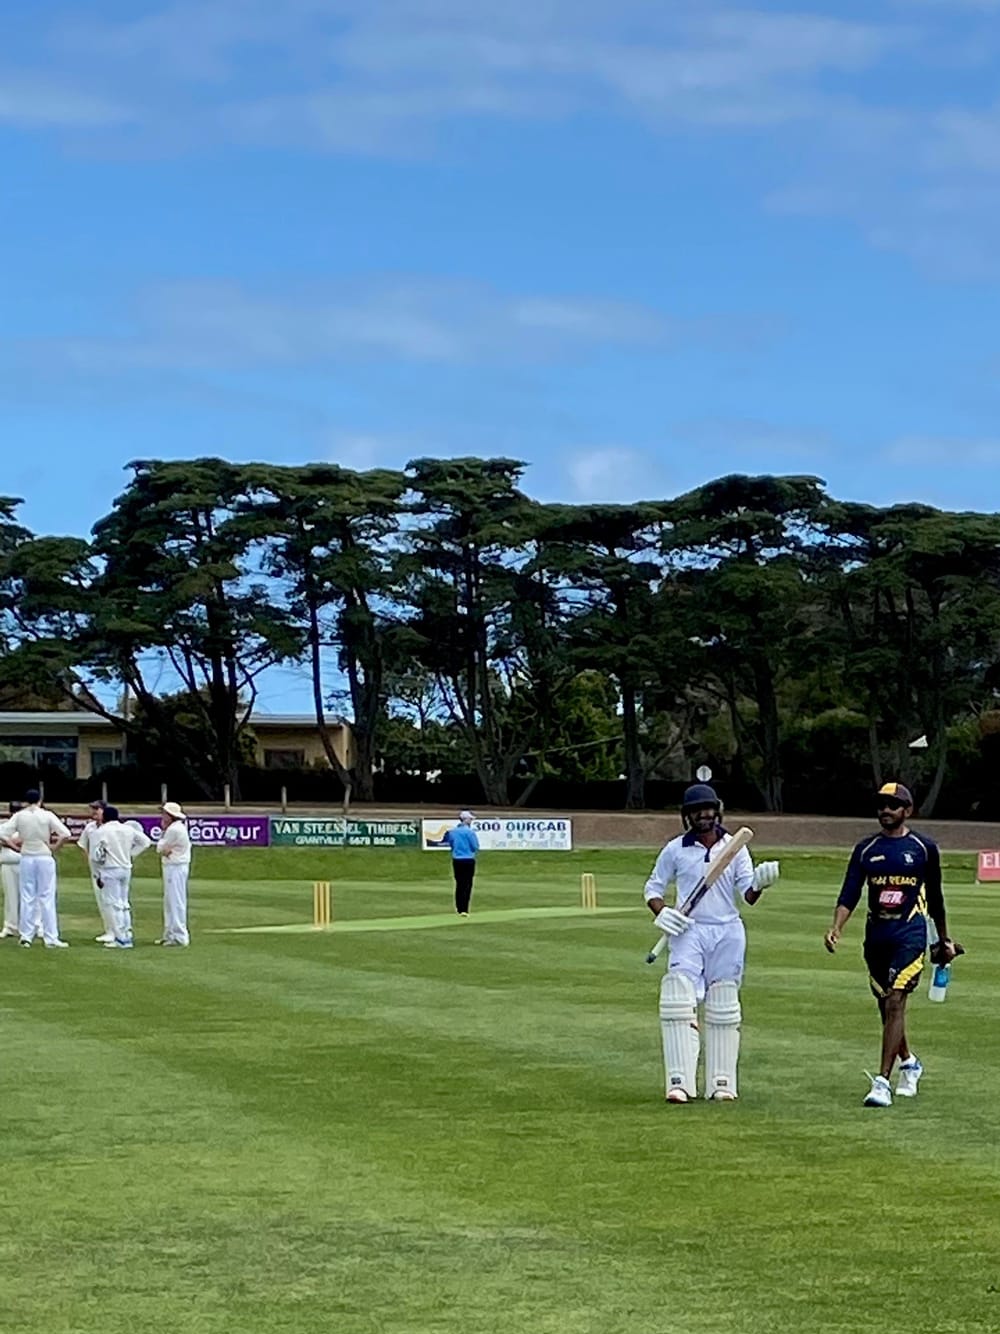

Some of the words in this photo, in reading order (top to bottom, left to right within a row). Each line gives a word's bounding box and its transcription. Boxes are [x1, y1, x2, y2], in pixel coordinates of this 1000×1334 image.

[150, 826, 261, 840] eeavour
[274, 822, 300, 834] VAN
[366, 823, 417, 836] TIMBERS
[473, 822, 500, 832] 300
[506, 822, 567, 832] OURCAB
